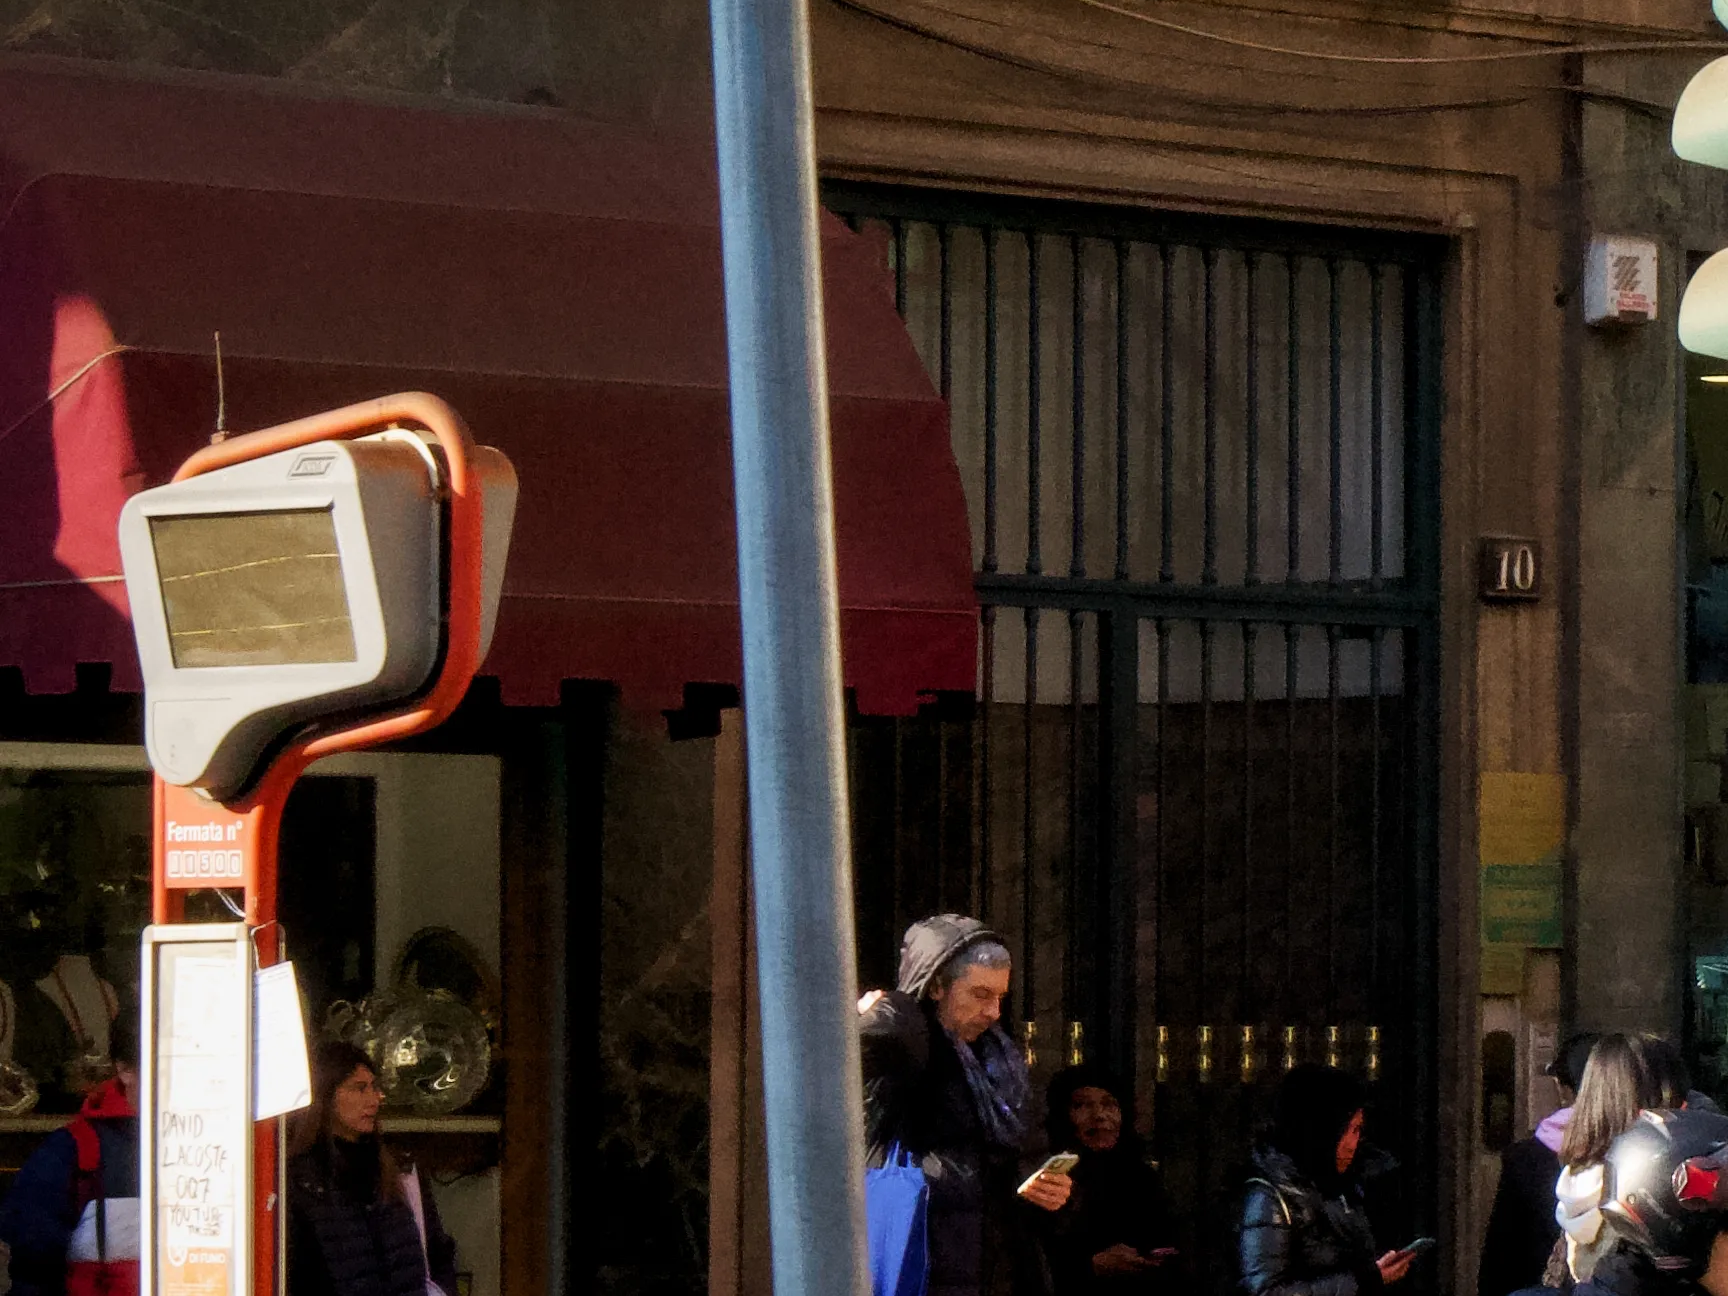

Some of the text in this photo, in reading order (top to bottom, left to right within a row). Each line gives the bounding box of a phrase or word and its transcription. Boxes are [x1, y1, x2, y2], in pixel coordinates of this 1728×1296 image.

[1493, 544, 1536, 593] 10
[167, 821, 223, 842] Fermata
[162, 1110, 204, 1138] DAVID
[162, 1143, 228, 1174] LACOSTE
